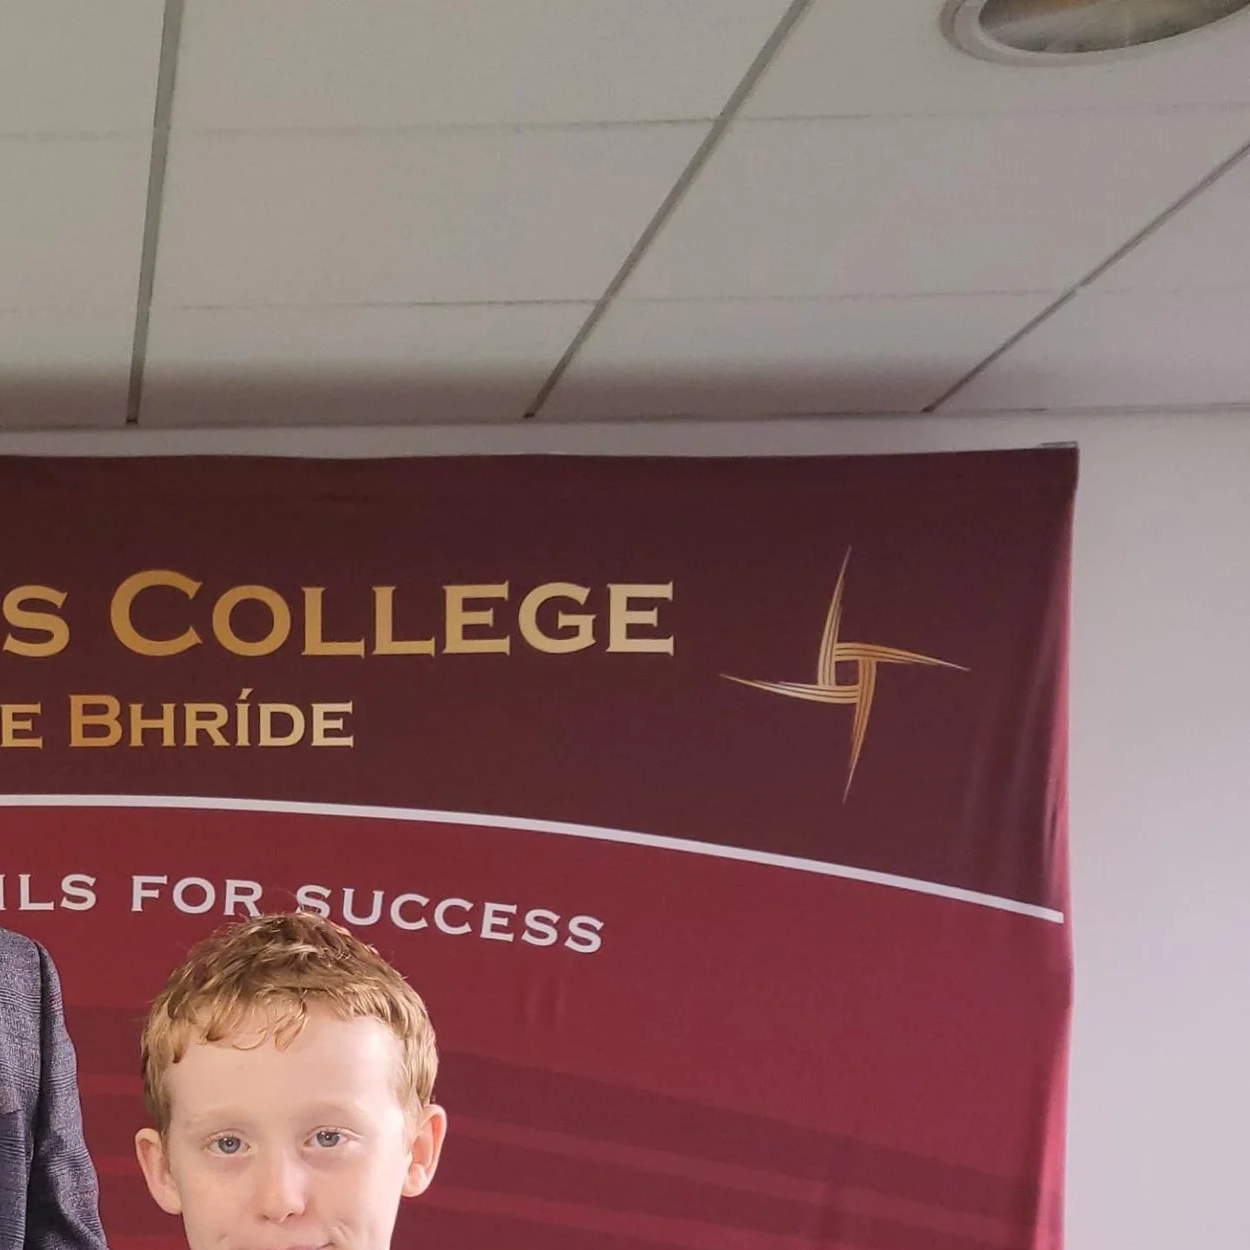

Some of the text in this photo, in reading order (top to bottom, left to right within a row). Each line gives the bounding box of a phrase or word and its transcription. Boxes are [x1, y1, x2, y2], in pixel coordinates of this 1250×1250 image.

[110, 569, 675, 658] COLLEGE
[68, 687, 354, 748] BHRÍDE
[131, 875, 263, 917] FOR
[295, 884, 605, 953] SUCCESS
